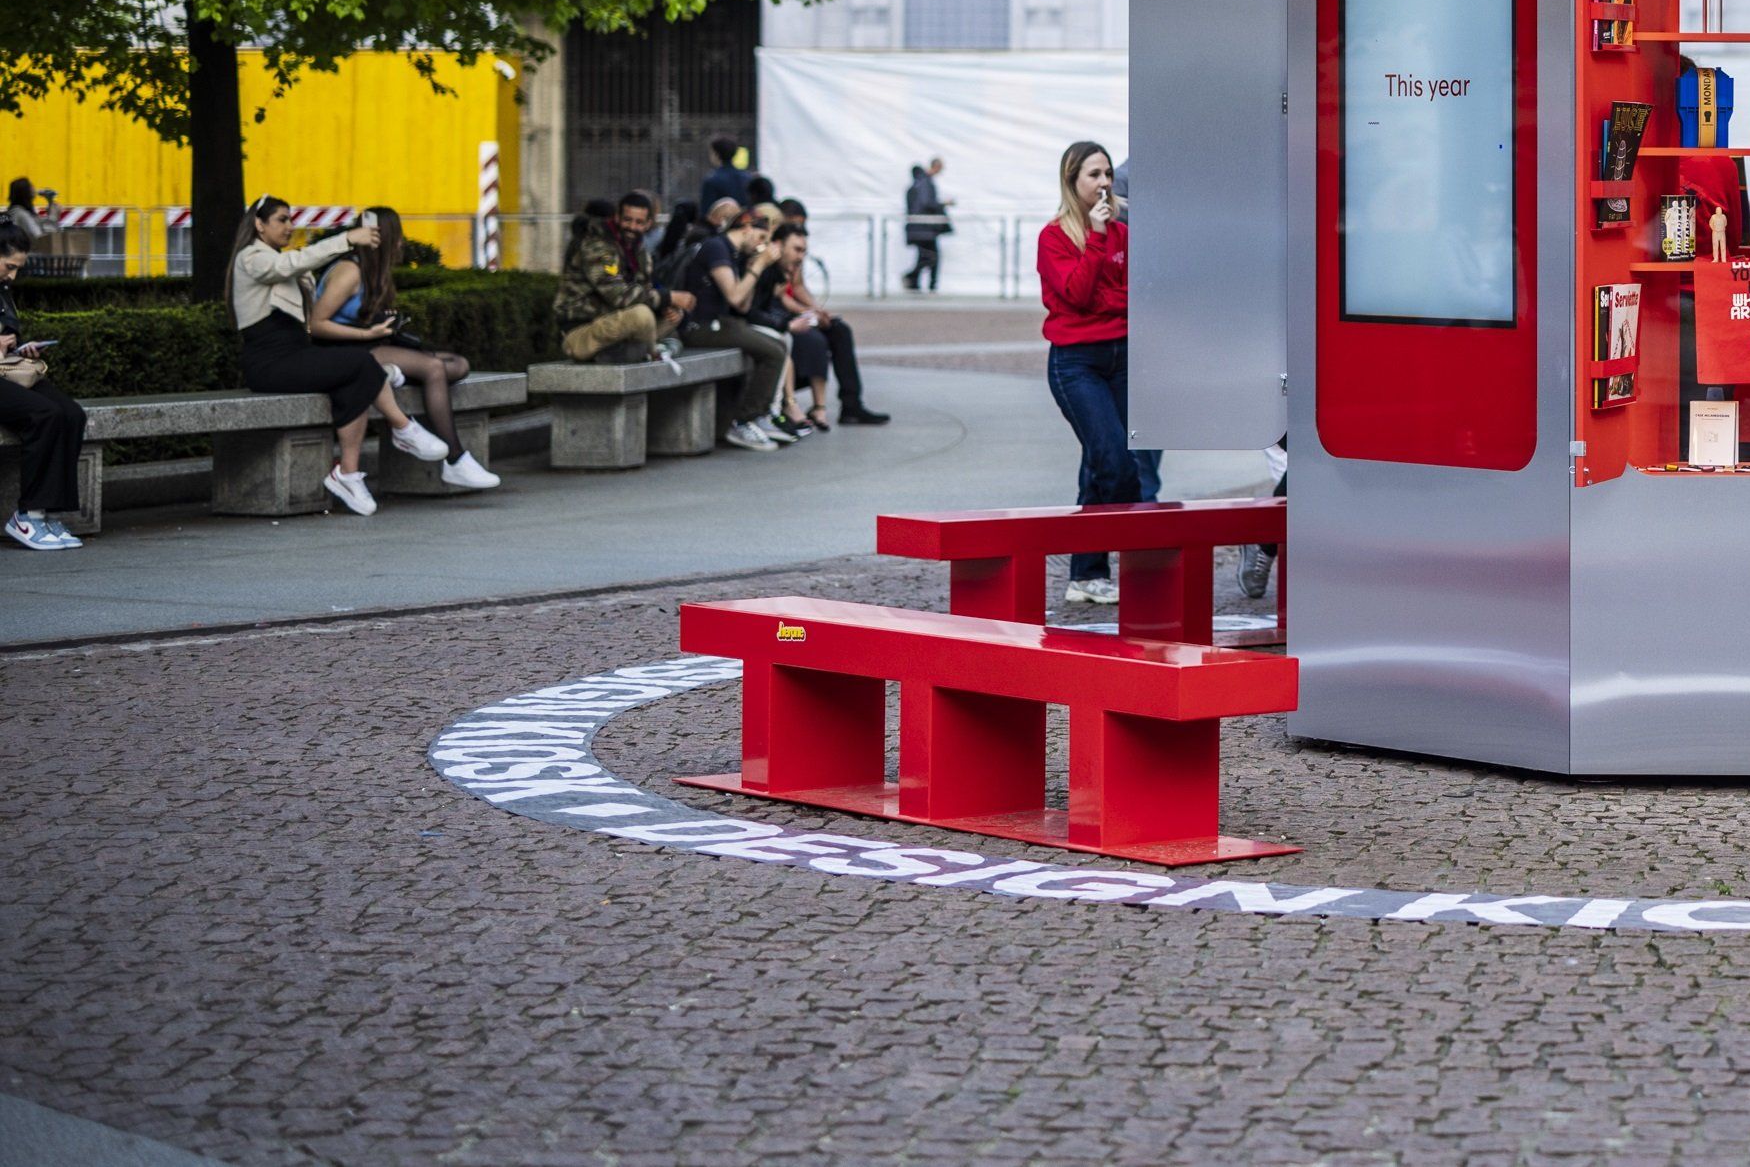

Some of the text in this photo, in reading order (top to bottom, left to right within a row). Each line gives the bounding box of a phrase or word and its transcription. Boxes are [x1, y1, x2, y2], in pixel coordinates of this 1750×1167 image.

[1384, 73, 1470, 102] This year
[1614, 290, 1639, 308] Serviette
[433, 721, 646, 803] KIOSK
[594, 818, 1366, 914] DESIGN
